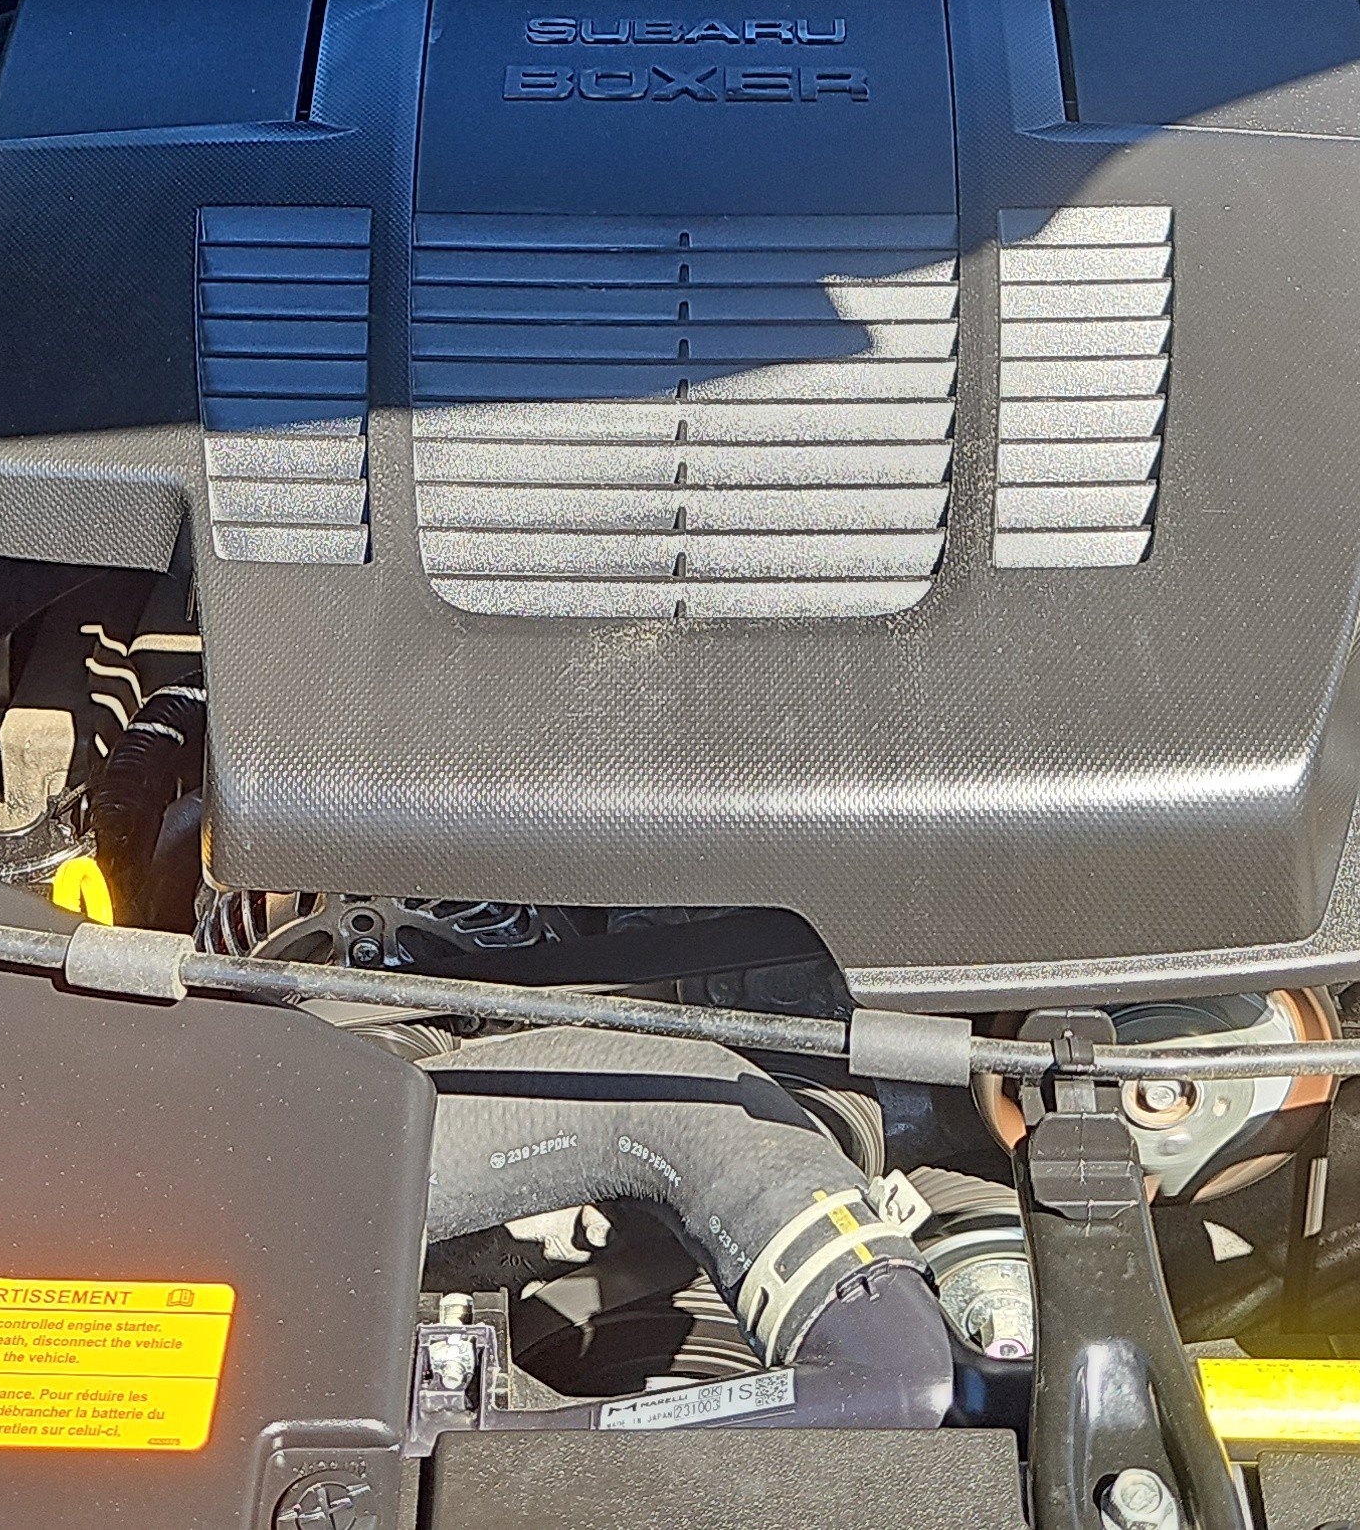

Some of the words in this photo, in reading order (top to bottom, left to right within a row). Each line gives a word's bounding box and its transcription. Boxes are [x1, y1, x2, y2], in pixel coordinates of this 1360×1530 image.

[525, 17, 847, 45] SUBARU
[502, 64, 870, 102] BOXER
[68, 1320, 112, 1334] engine
[116, 1322, 162, 1332] starter.
[32, 1335, 107, 1348] disconnect
[110, 1336, 131, 1348] the
[136, 1337, 184, 1349] vehicle
[3, 1351, 25, 1363] the
[29, 1352, 80, 1364] vehicle.
[39, 1388, 74, 1400] Pour
[76, 1389, 124, 1402] réduire
[128, 1390, 148, 1402] les
[640, 1394, 688, 1409] MARELLI
[700, 1387, 721, 1398] OK
[76, 1406, 87, 1418] la
[91, 1407, 144, 1420] batterie
[147, 1408, 165, 1420] du
[647, 1411, 673, 1423] JAPAN
[675, 1399, 720, 1419] 231003
[41, 1425, 64, 1436] sur
[67, 1424, 122, 1437] celui-ci.
